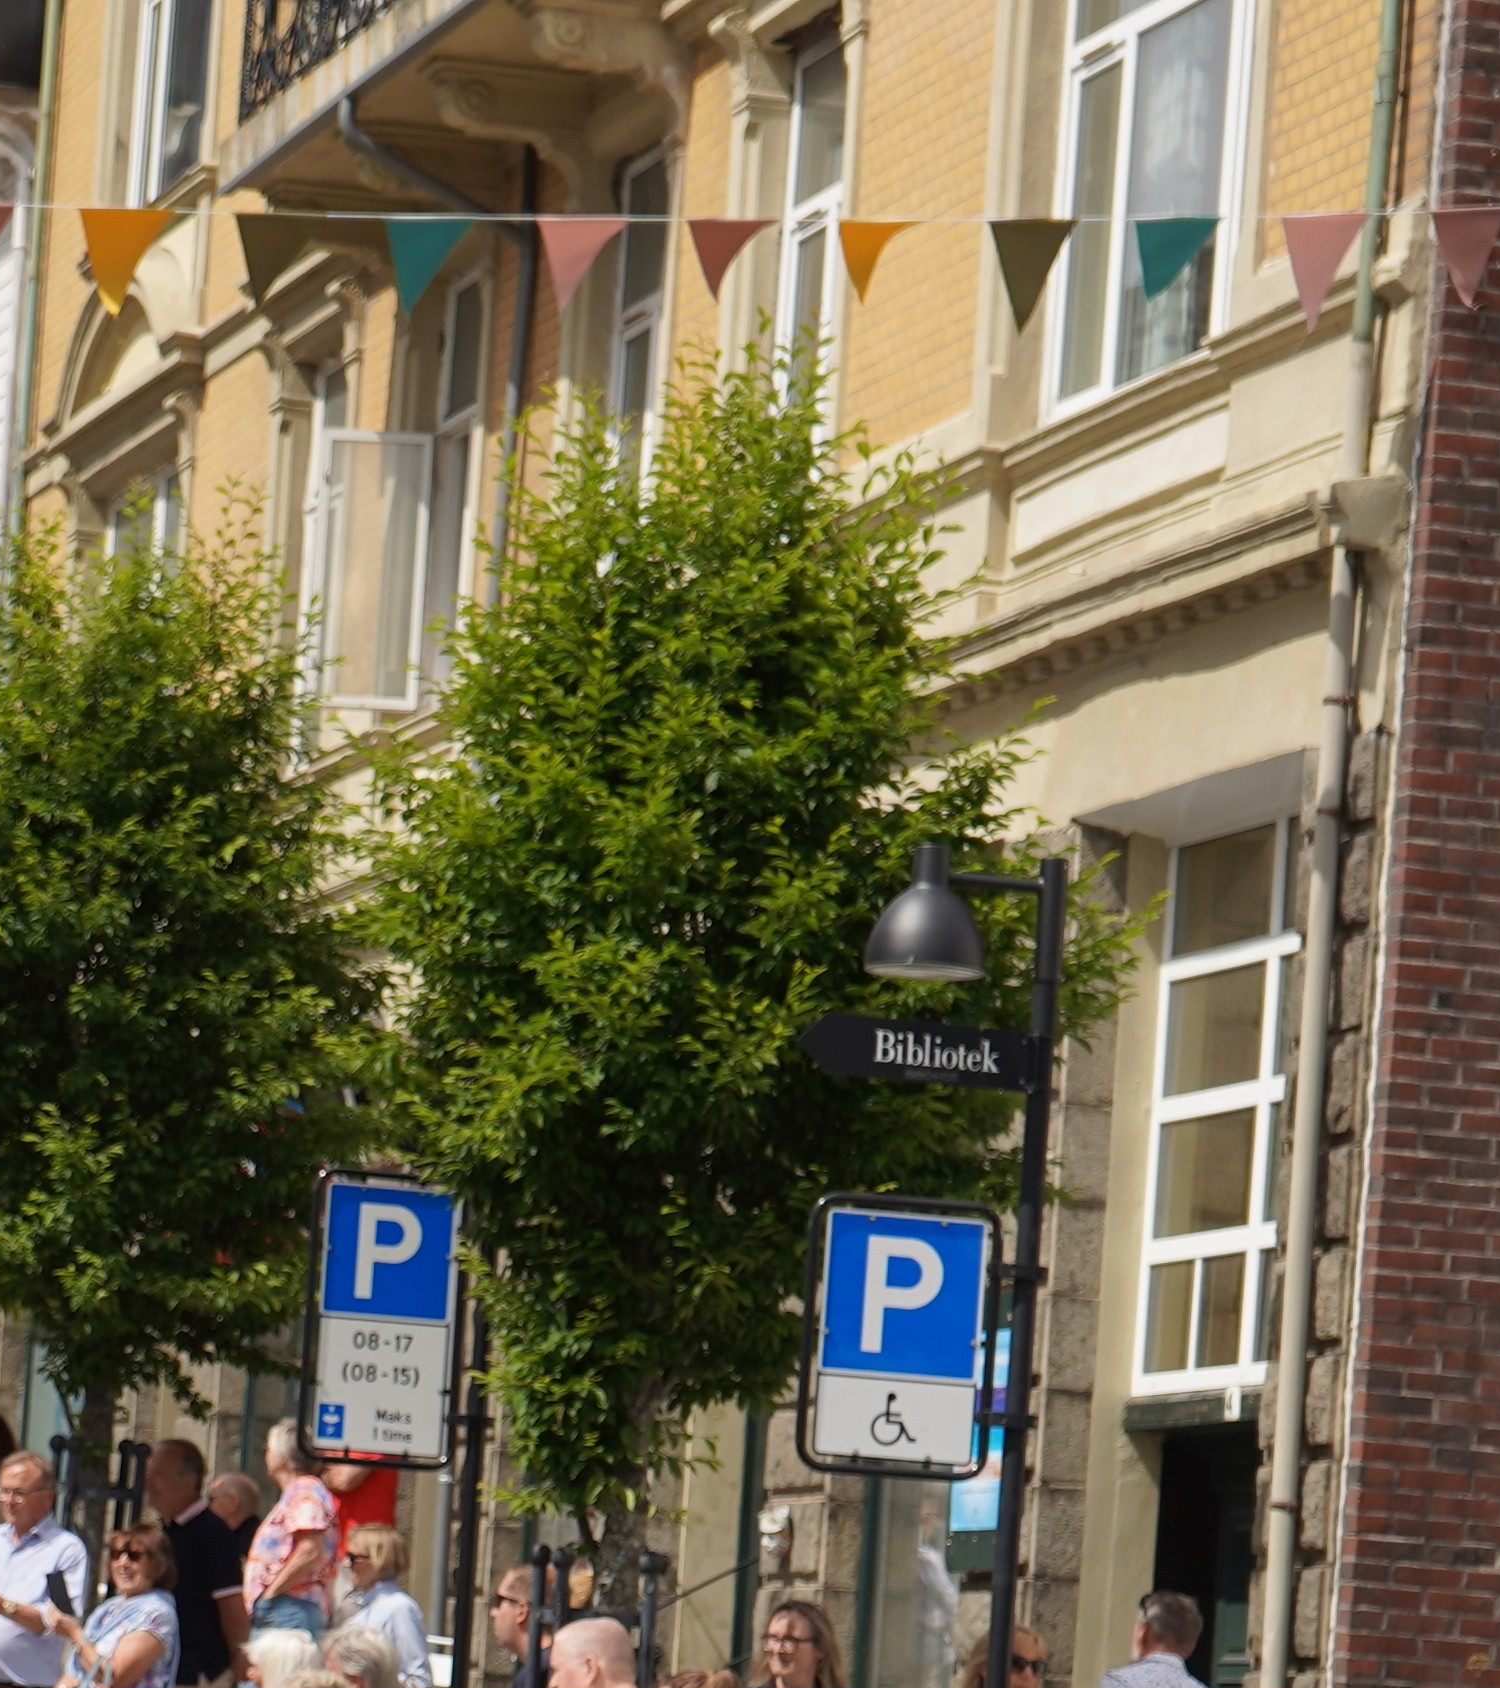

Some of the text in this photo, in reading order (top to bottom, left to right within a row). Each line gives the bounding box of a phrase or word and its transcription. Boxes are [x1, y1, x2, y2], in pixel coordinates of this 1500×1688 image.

[873, 1028, 1000, 1074] Bibliotek
[353, 1201, 423, 1300] P
[860, 1234, 945, 1354] P
[352, 1331, 414, 1354] 08-17
[341, 1361, 420, 1388] (08-15)
[375, 1408, 412, 1425] Maks
[382, 1427, 412, 1443] time
